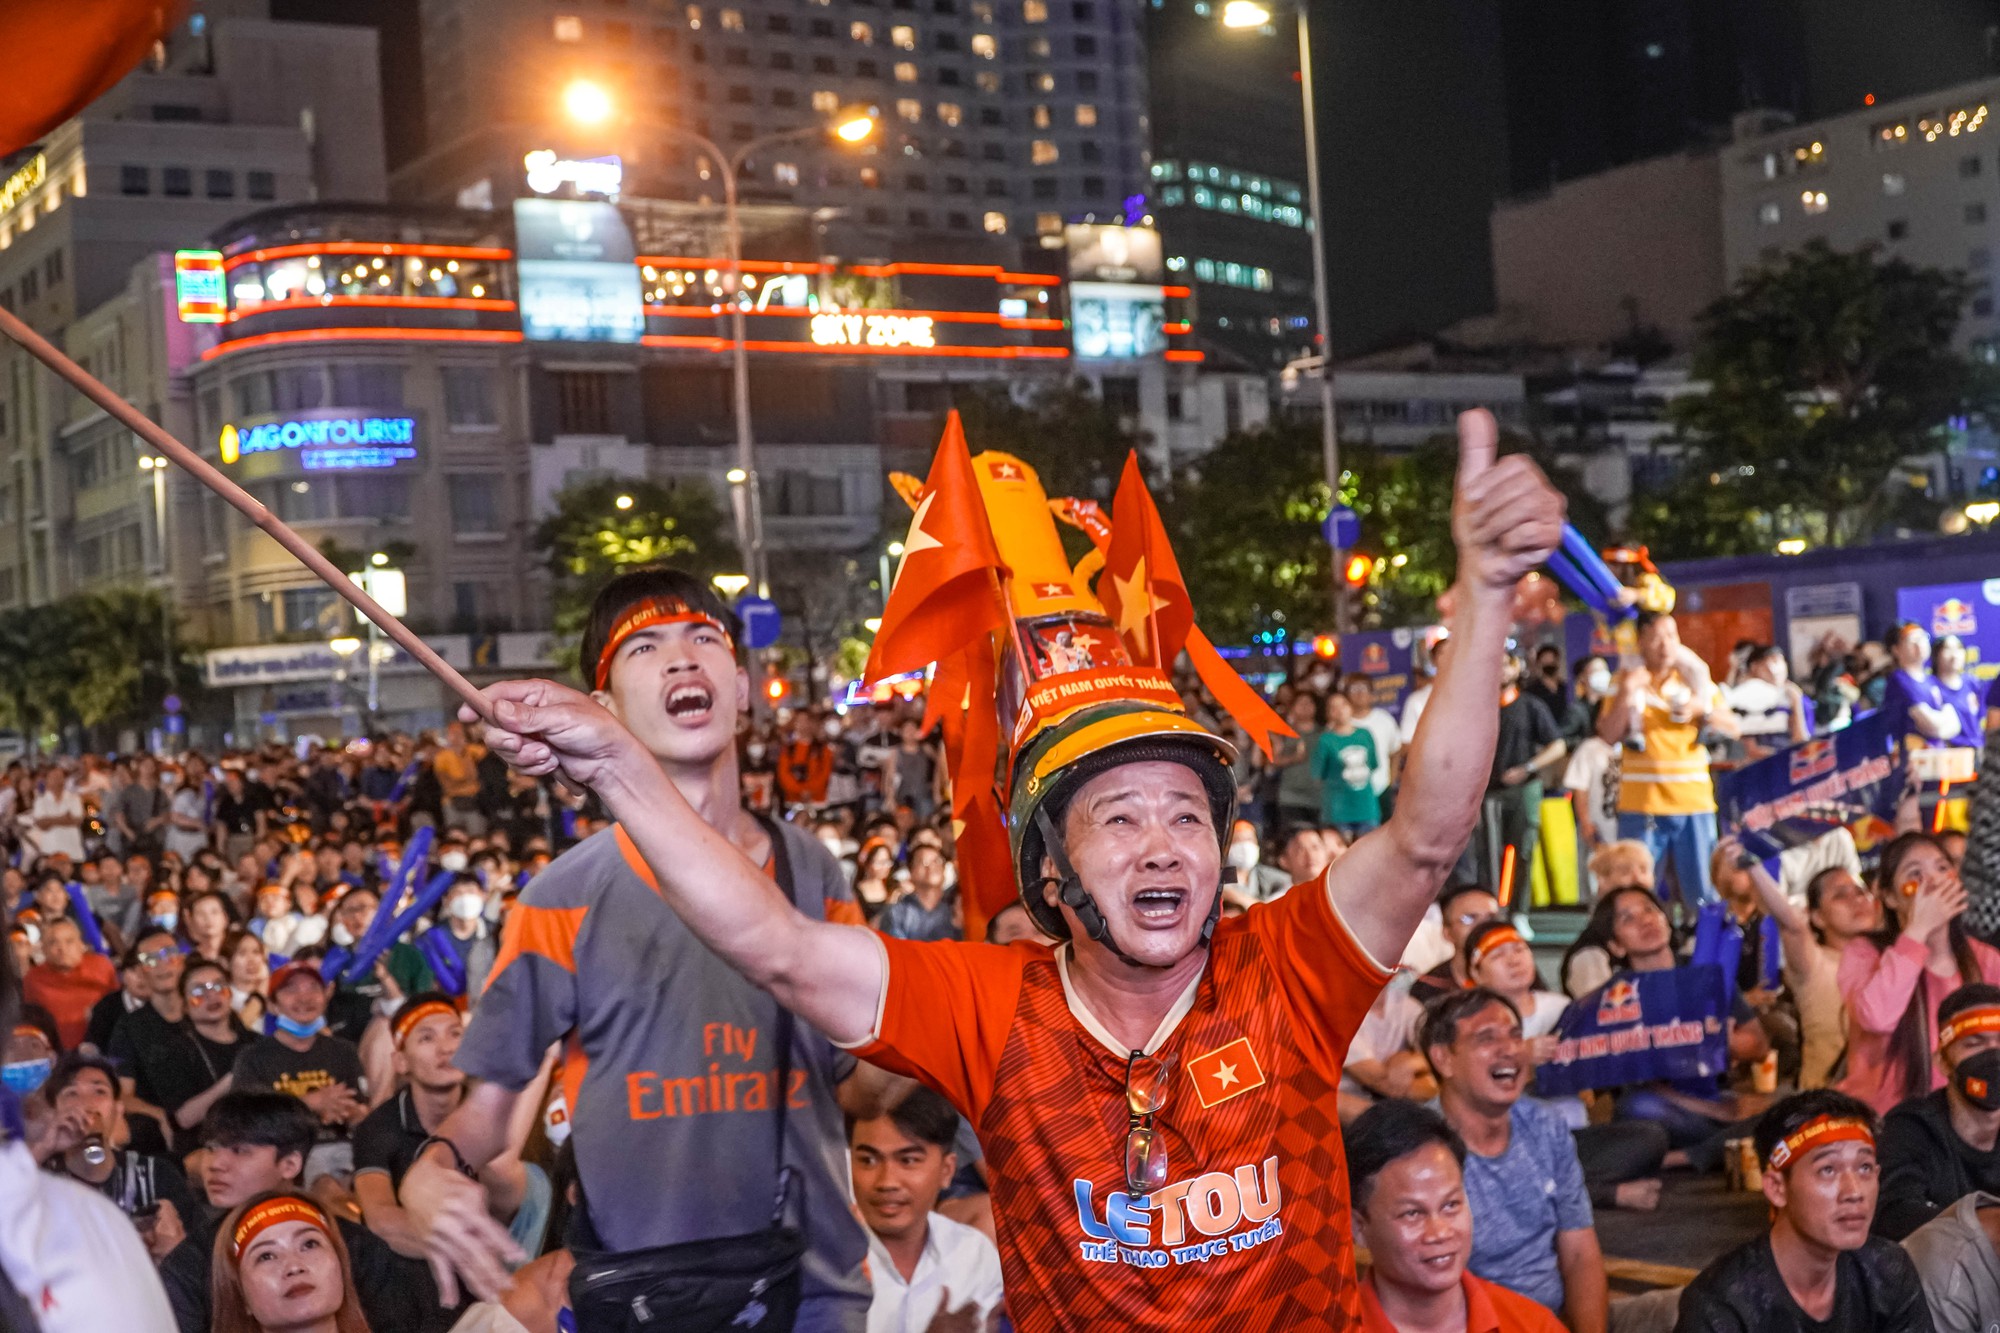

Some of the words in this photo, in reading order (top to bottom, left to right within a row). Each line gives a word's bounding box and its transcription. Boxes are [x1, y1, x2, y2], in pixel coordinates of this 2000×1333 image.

[811, 313, 863, 345] SKY
[1030, 688, 1058, 708] VIỆT
[1060, 679, 1093, 697] NAM
[1094, 675, 1134, 692] QUYẾT
[703, 1022, 757, 1062] Fly
[1074, 1155, 1281, 1246] LETOU
[1119, 1247, 1169, 1269] THAO
[1172, 1239, 1228, 1264] TRỰC
[1230, 1216, 1283, 1252] TUYẾN
